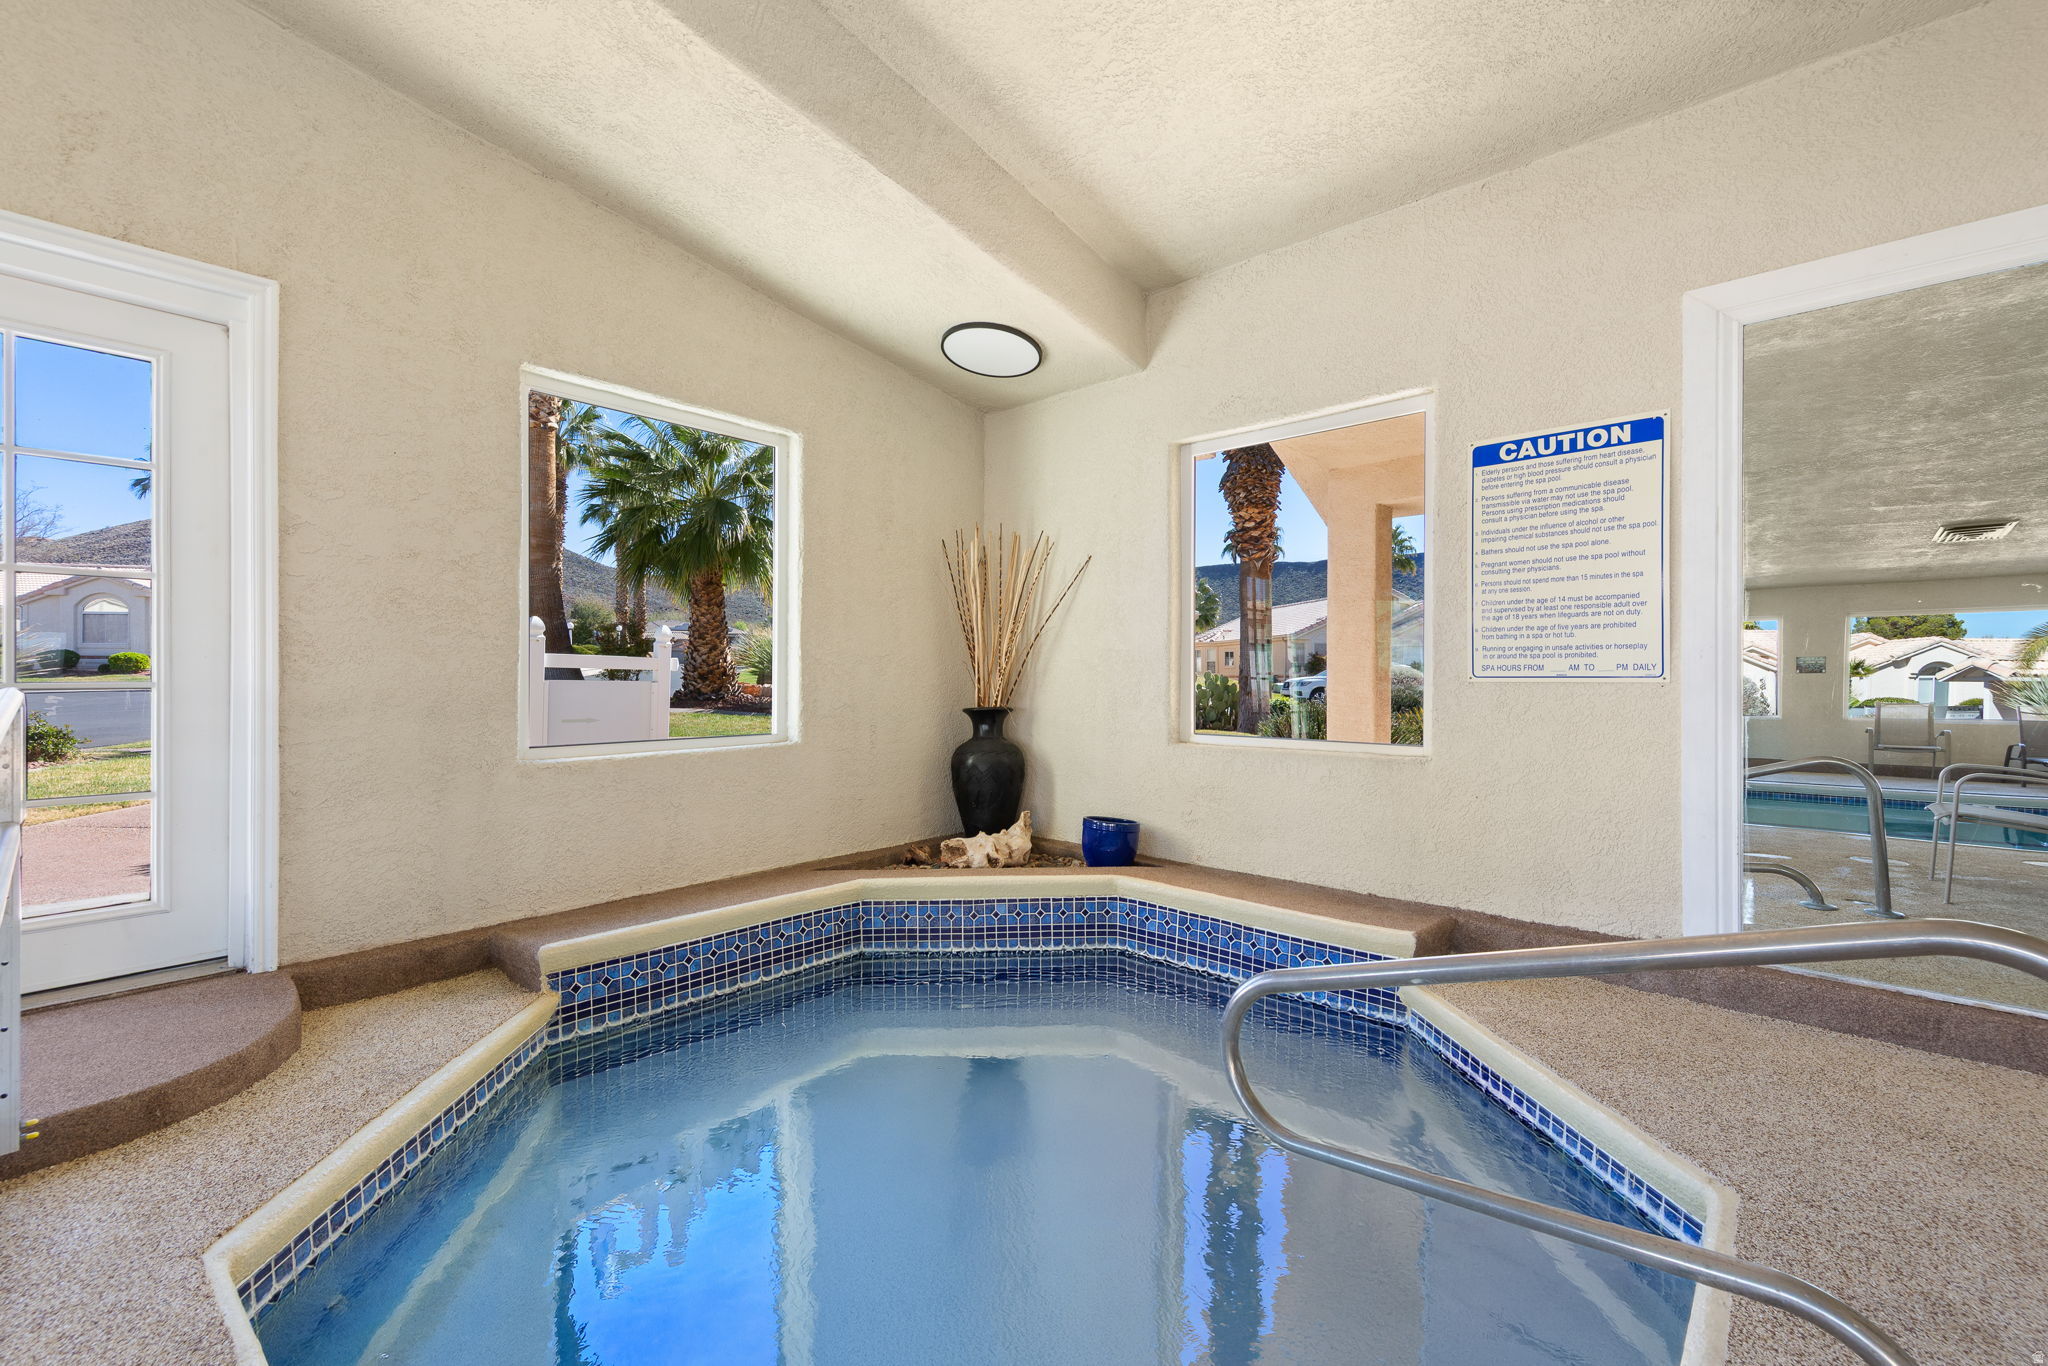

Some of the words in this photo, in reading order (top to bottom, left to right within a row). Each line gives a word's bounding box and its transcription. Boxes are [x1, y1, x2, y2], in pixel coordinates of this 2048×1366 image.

[1499, 424, 1632, 462] CAUTION
[1501, 465, 1524, 475] persons
[1556, 456, 1582, 465] suffering
[1527, 469, 1543, 477] blood
[1545, 466, 1571, 476] pressure
[1572, 462, 1593, 471] should
[1594, 458, 1617, 468] consult
[1506, 491, 1532, 499] suffering
[1603, 478, 1629, 486] disease
[1602, 493, 1625, 503] should
[1481, 516, 1502, 524] consult
[1509, 513, 1537, 522] physician
[1575, 517, 1598, 526] alcohol
[1508, 532, 1533, 541] chemical
[1534, 529, 1568, 538] substances
[1569, 526, 1590, 534] should
[1504, 545, 1524, 553] should
[1574, 539, 1589, 548] pool
[1480, 560, 1507, 569] Pregnant
[1604, 551, 1619, 560] pool
[1620, 549, 1645, 557] without
[1594, 591, 1640, 600] accompanied
[1602, 620, 1636, 630] prohibited
